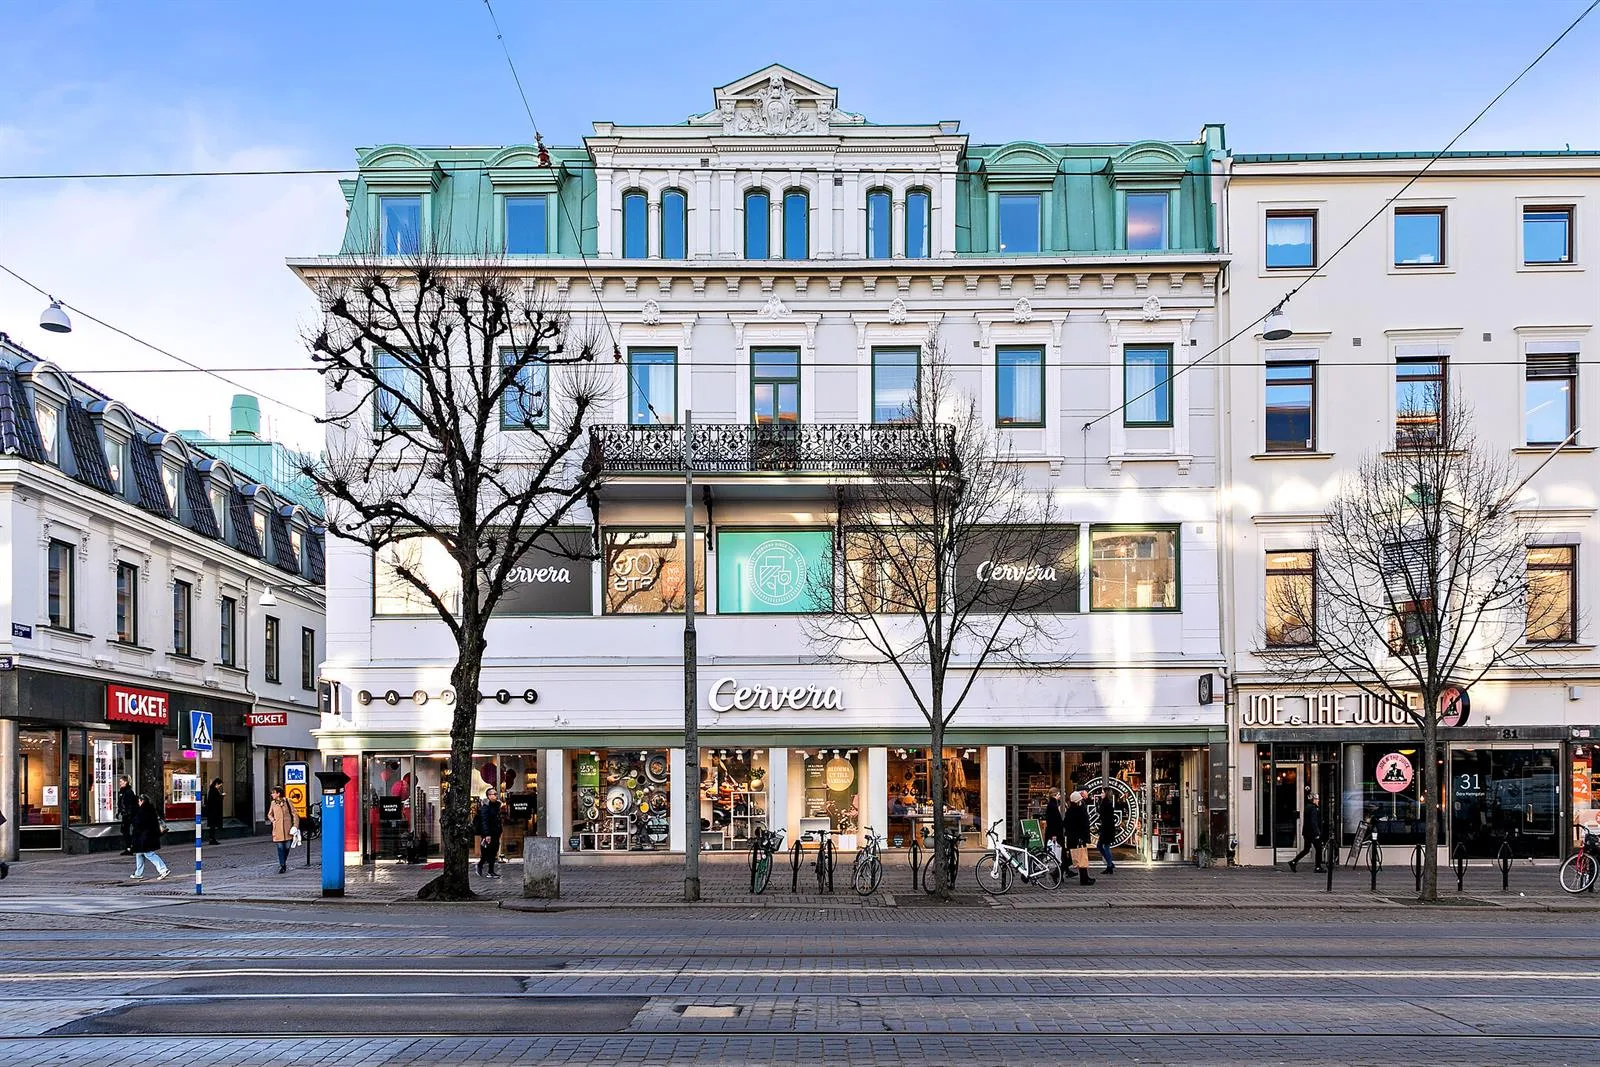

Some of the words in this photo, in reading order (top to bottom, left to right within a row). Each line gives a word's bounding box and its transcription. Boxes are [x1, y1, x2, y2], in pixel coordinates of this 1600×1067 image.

[976, 560, 1057, 582] Cervera
[707, 677, 846, 713] Cervera
[1243, 694, 1285, 726] JOE
[1289, 715, 1302, 725] &
[1304, 694, 1346, 725] THE
[1353, 693, 1418, 725] JUICE
[1460, 773, 1481, 789] 31
